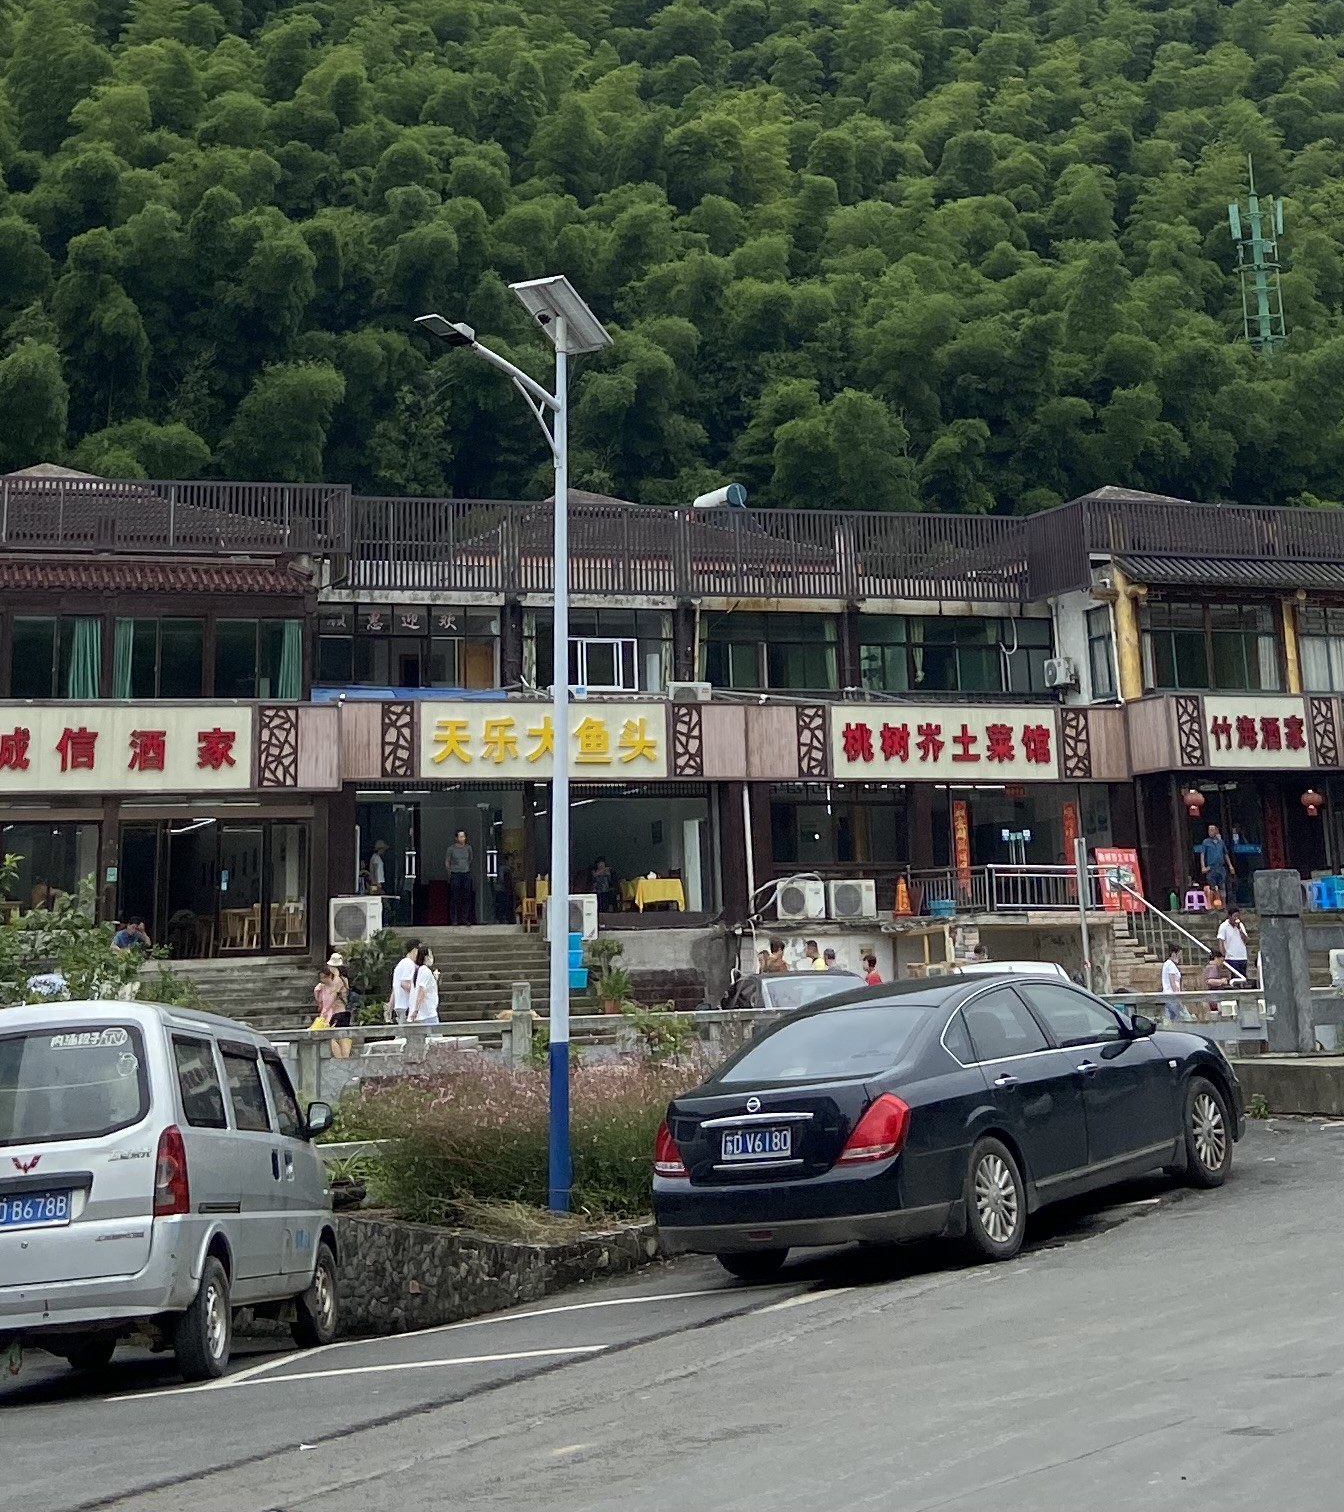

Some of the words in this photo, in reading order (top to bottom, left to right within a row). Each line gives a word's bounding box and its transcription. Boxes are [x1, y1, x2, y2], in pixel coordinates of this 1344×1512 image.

[432, 716, 657, 764] 天乐大鱼头
[842, 722, 1051, 764] 桃树岕土菜馆
[1211, 715, 1307, 751] 竹海酒家
